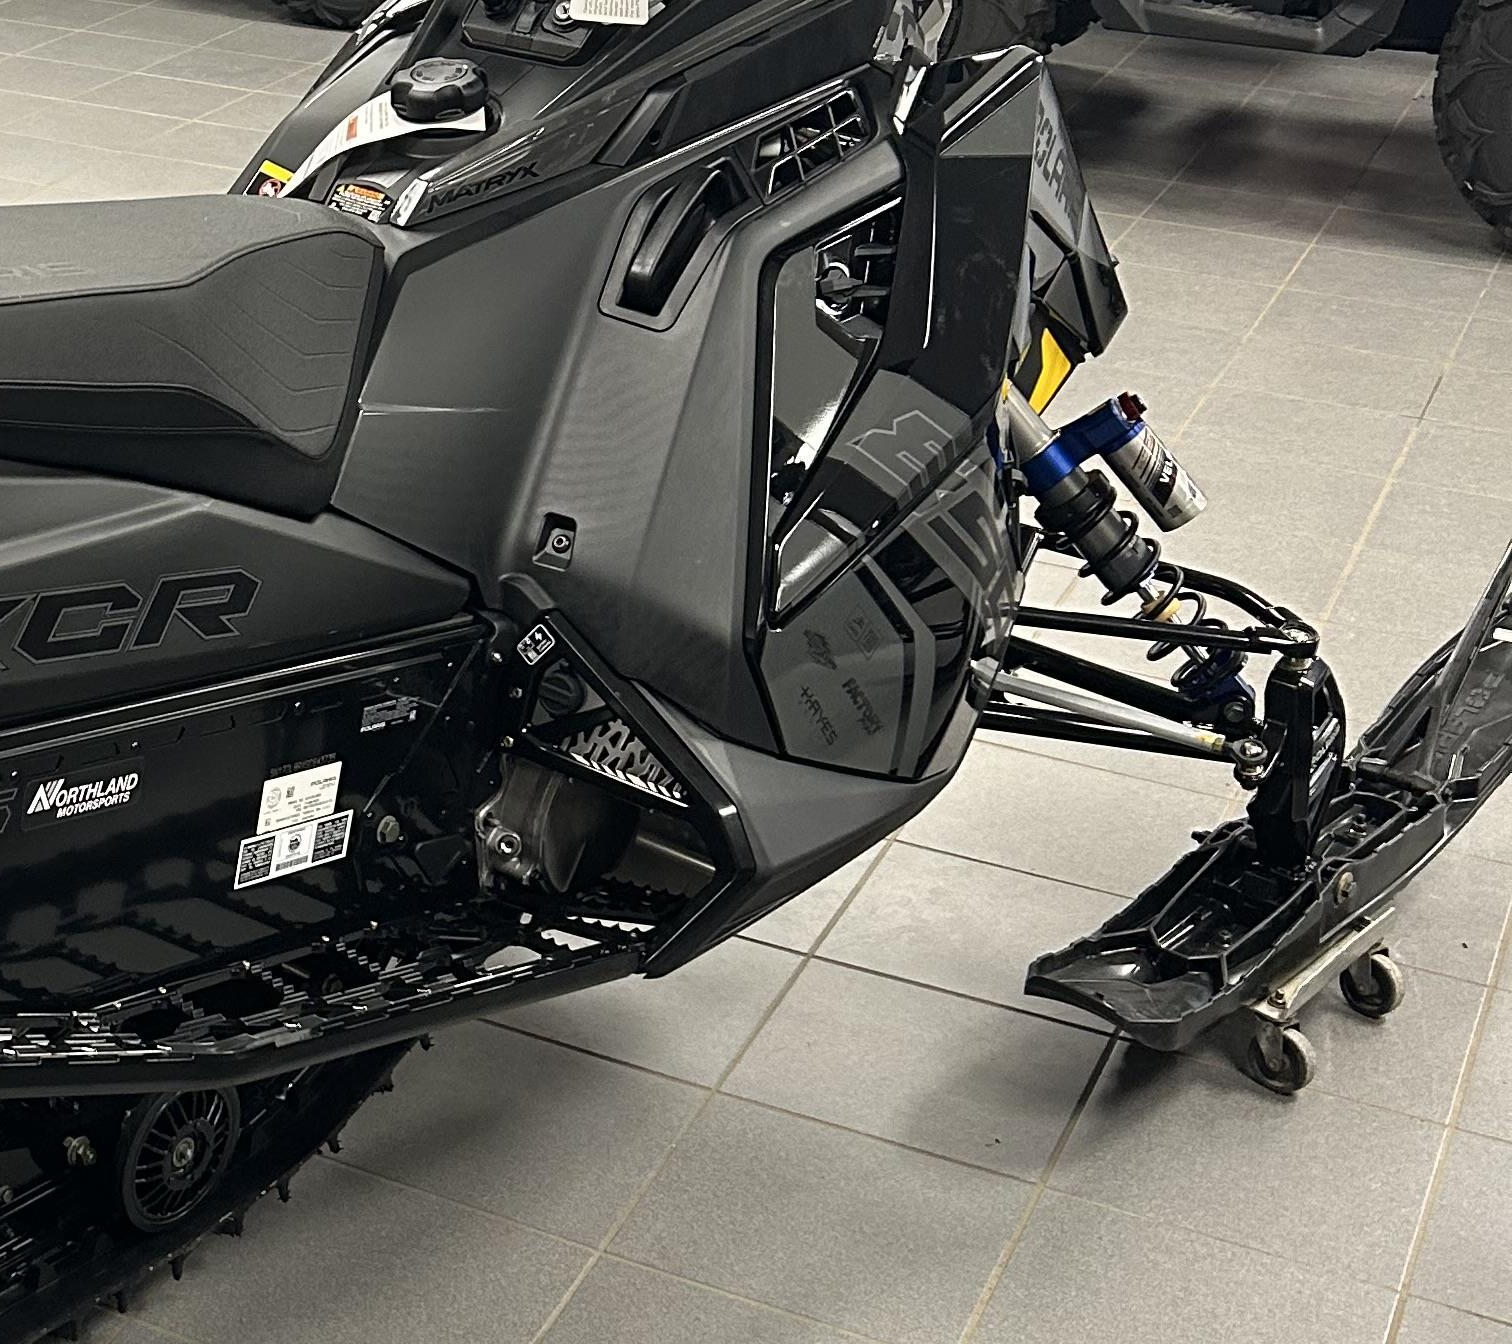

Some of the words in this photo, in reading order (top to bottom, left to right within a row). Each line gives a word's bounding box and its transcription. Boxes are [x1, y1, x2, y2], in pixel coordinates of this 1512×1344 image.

[424, 161, 540, 213] MATRYX
[27, 773, 138, 814] NORTHLAND
[56, 791, 130, 818] MOTORSPORTS
